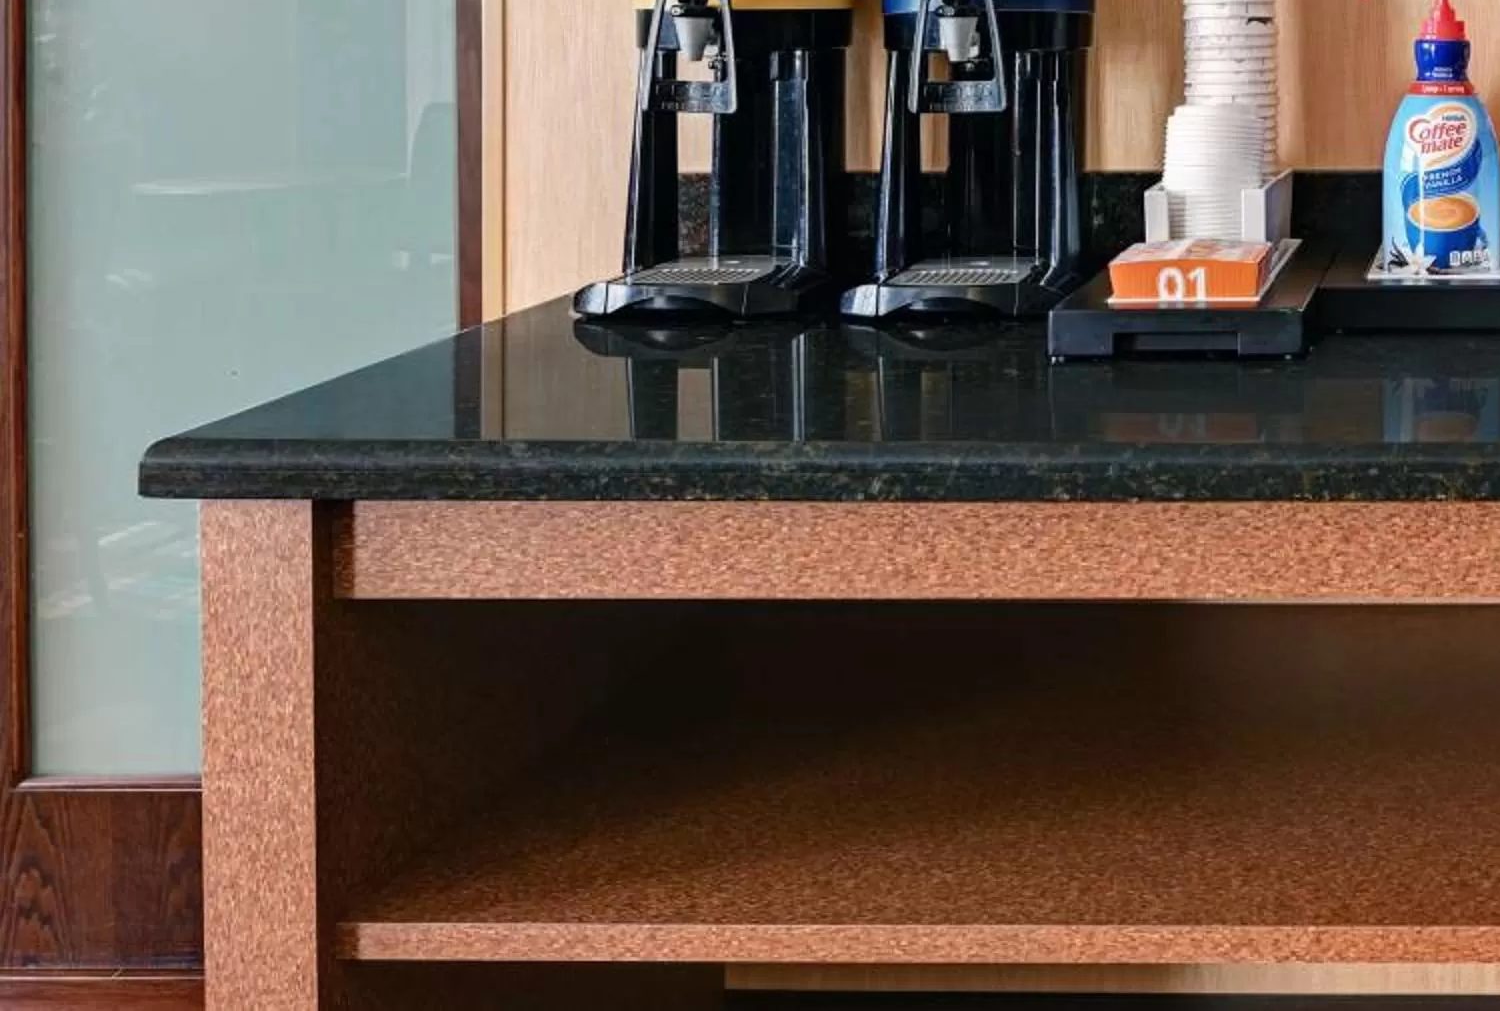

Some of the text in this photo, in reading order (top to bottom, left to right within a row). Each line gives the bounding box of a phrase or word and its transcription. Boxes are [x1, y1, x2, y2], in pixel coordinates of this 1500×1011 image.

[1408, 116, 1467, 143] Coffee
[1421, 136, 1463, 154] mate
[1157, 266, 1209, 308] 01
